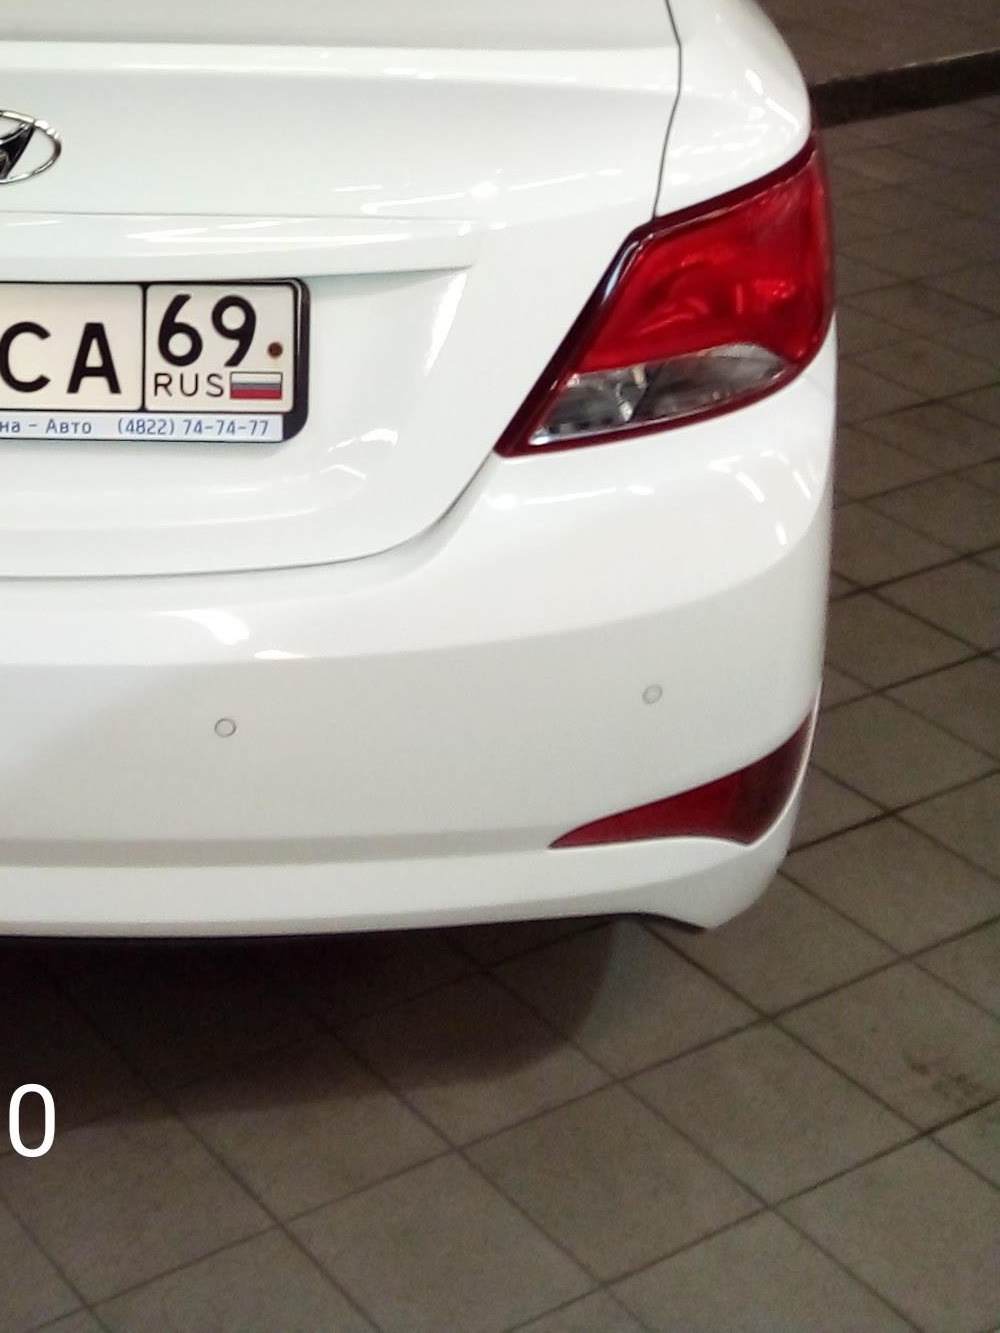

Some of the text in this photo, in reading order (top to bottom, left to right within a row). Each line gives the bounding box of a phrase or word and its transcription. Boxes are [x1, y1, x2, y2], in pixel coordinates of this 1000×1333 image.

[158, 294, 257, 367] 69
[153, 372, 225, 398] RUS
[45, 418, 92, 434] Авто
[117, 417, 175, 437] (4822)
[183, 418, 269, 436] 74-74-77
